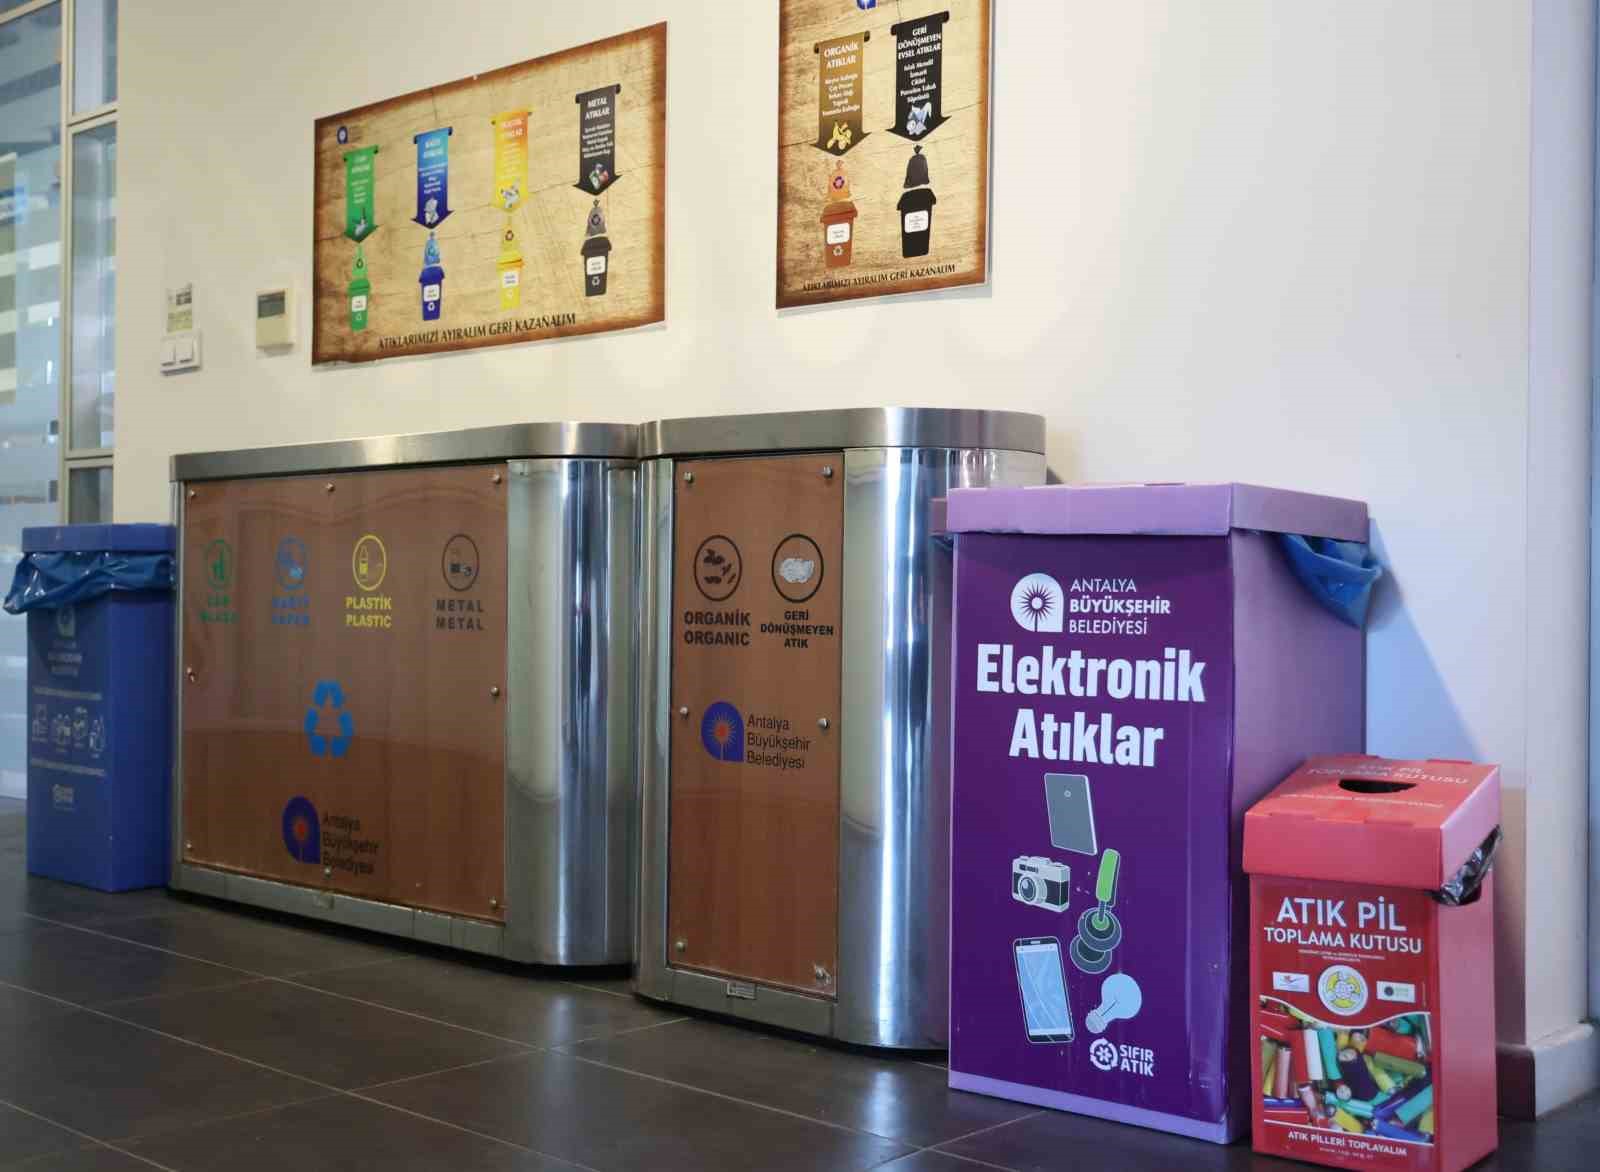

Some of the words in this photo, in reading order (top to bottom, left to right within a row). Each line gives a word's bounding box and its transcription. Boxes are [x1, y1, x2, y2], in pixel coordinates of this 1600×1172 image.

[912, 23, 927, 36] GERİ
[824, 40, 859, 58] ORGANİK
[898, 32, 942, 50] DÖNÜŞMEYEN
[898, 49, 915, 60] EVSEL
[916, 43, 942, 56] ATIKLAR
[826, 55, 857, 70] ATIKLAR
[587, 97, 608, 108] METAL
[584, 106, 611, 121] ATIKLAR
[909, 263, 956, 278] KAZANALIM
[441, 323, 488, 343] AYIRALIM
[488, 320, 513, 337] GERİ
[514, 312, 577, 333] KAZANALIM
[1069, 578, 1137, 593] ANTALYA
[345, 594, 392, 611] PLASTİK
[435, 599, 484, 613] METAL
[1069, 595, 1171, 616] BÜYÜKŞEHİR
[345, 615, 392, 629] PLASTIC
[435, 616, 485, 631] METAL
[684, 608, 751, 626] ORGANİK
[784, 609, 809, 621] GERİ
[760, 621, 834, 637] DÖNÜŞMEYEN
[1069, 616, 1149, 635] BELEDİYESİ
[684, 630, 750, 646] ORGANIC
[784, 638, 809, 649] ATIK
[976, 642, 1207, 703] Elektronik
[747, 714, 790, 732] Antalya
[747, 732, 811, 752] Büyükşehir
[1008, 707, 1165, 768] Atıklar
[747, 751, 805, 770] Belediyesi
[1276, 896, 1347, 928] ATIK
[1357, 895, 1407, 932] PİL
[1264, 926, 1345, 948] TOPLAMA
[1350, 933, 1423, 954] KUTUSU
[1119, 1044, 1154, 1062] SIFIR
[1120, 1060, 1154, 1077] ATIK
[1288, 1130, 1309, 1143] ATIK
[1349, 1139, 1408, 1157] TOPLAYALIM
